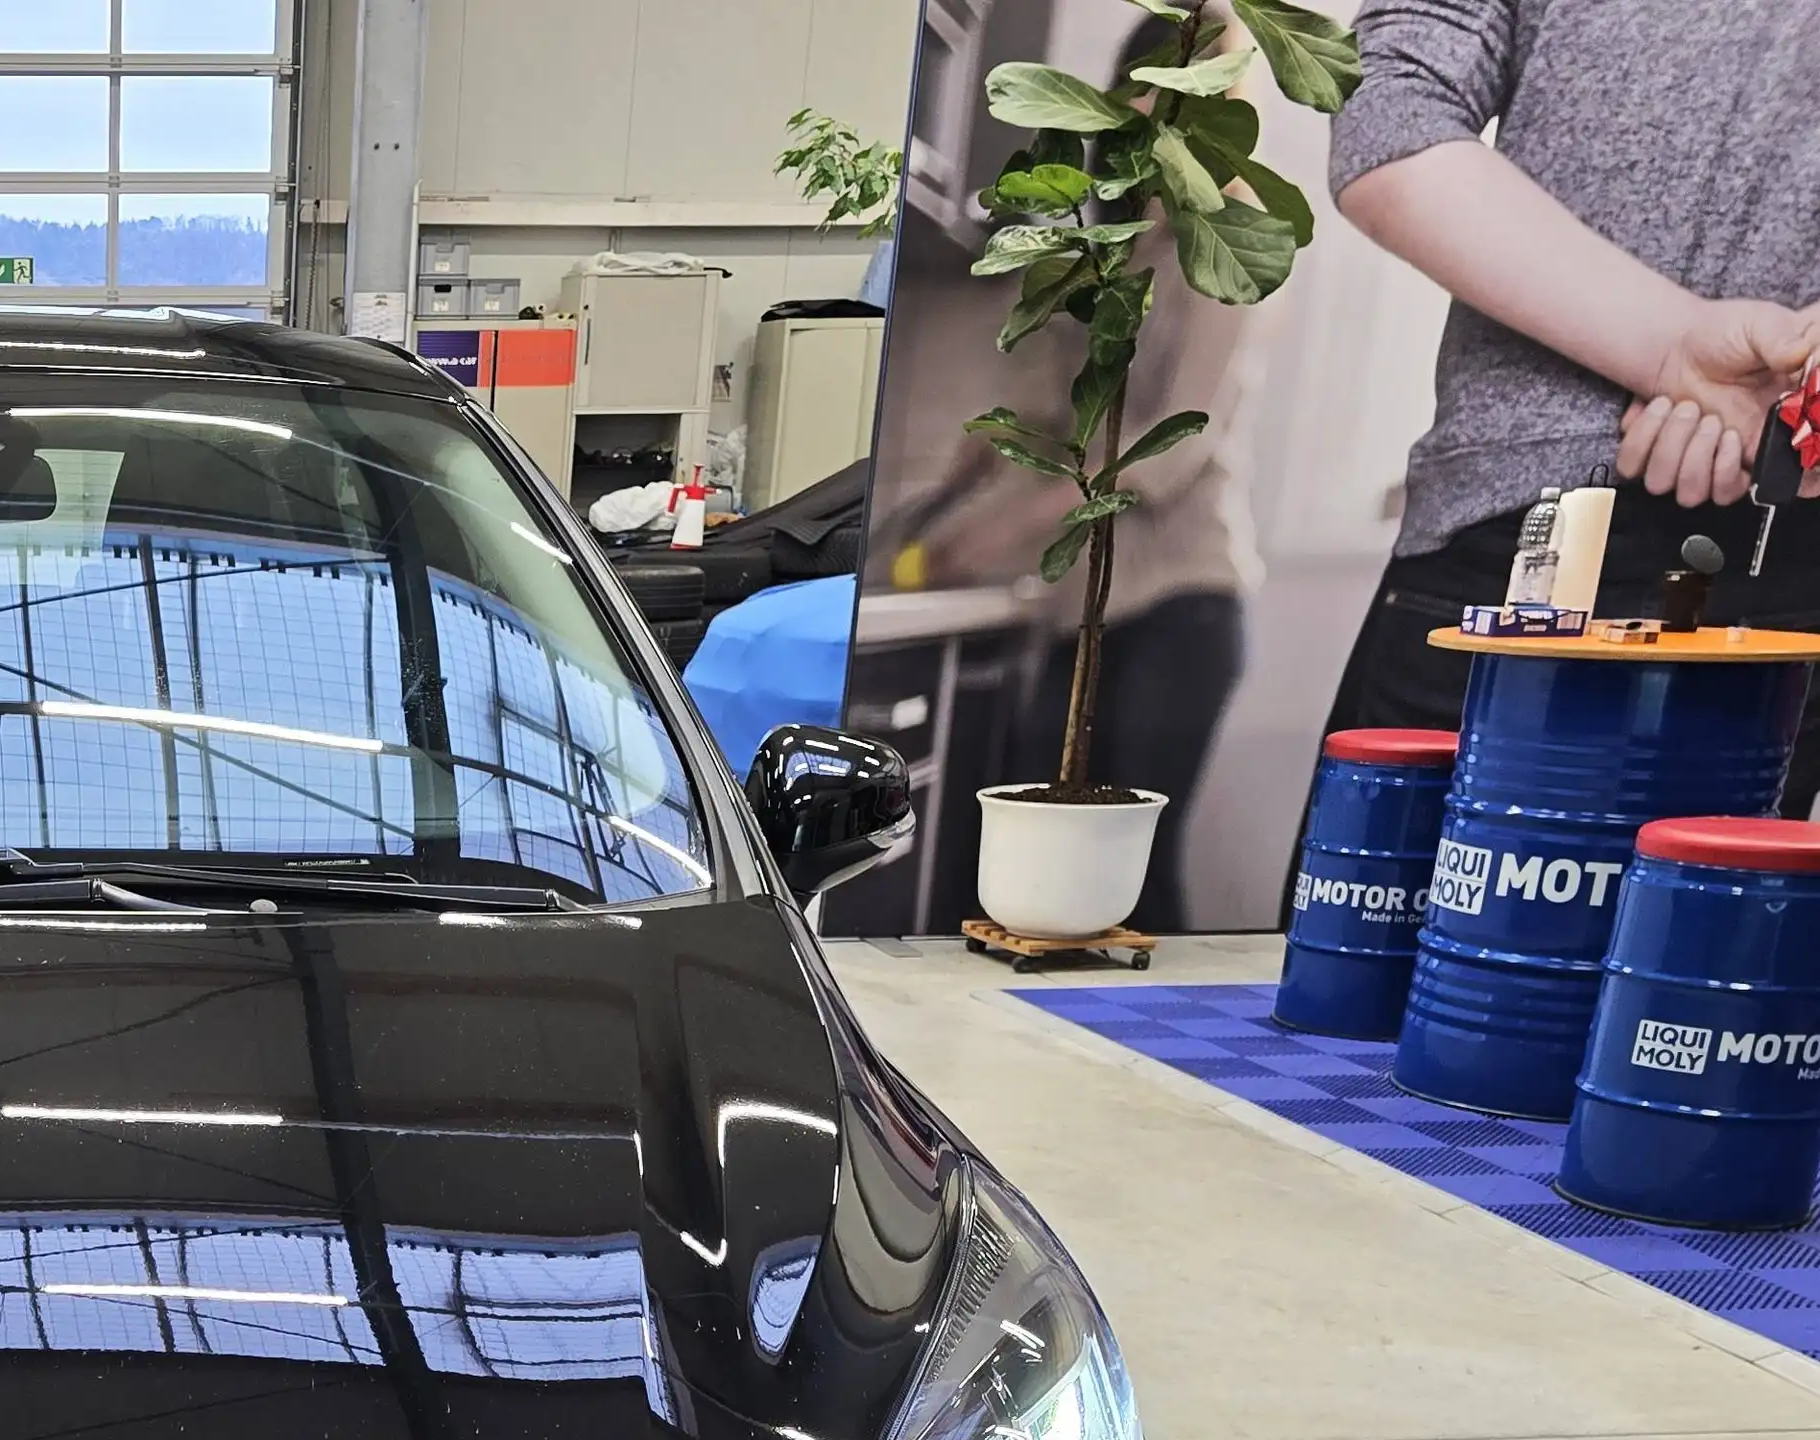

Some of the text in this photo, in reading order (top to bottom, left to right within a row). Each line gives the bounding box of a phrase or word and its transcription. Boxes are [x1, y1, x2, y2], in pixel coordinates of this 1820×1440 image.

[1437, 842, 1487, 879] LIQUI
[1311, 876, 1407, 912] MOTOR
[1430, 872, 1483, 910] MOLY
[1495, 852, 1622, 907] MOT
[1361, 910, 1392, 923] Made
[1394, 911, 1406, 924] in
[1640, 1022, 1708, 1050] LIQUI
[1716, 1030, 1820, 1065] MOTO
[1635, 1044, 1705, 1072] MOLY
